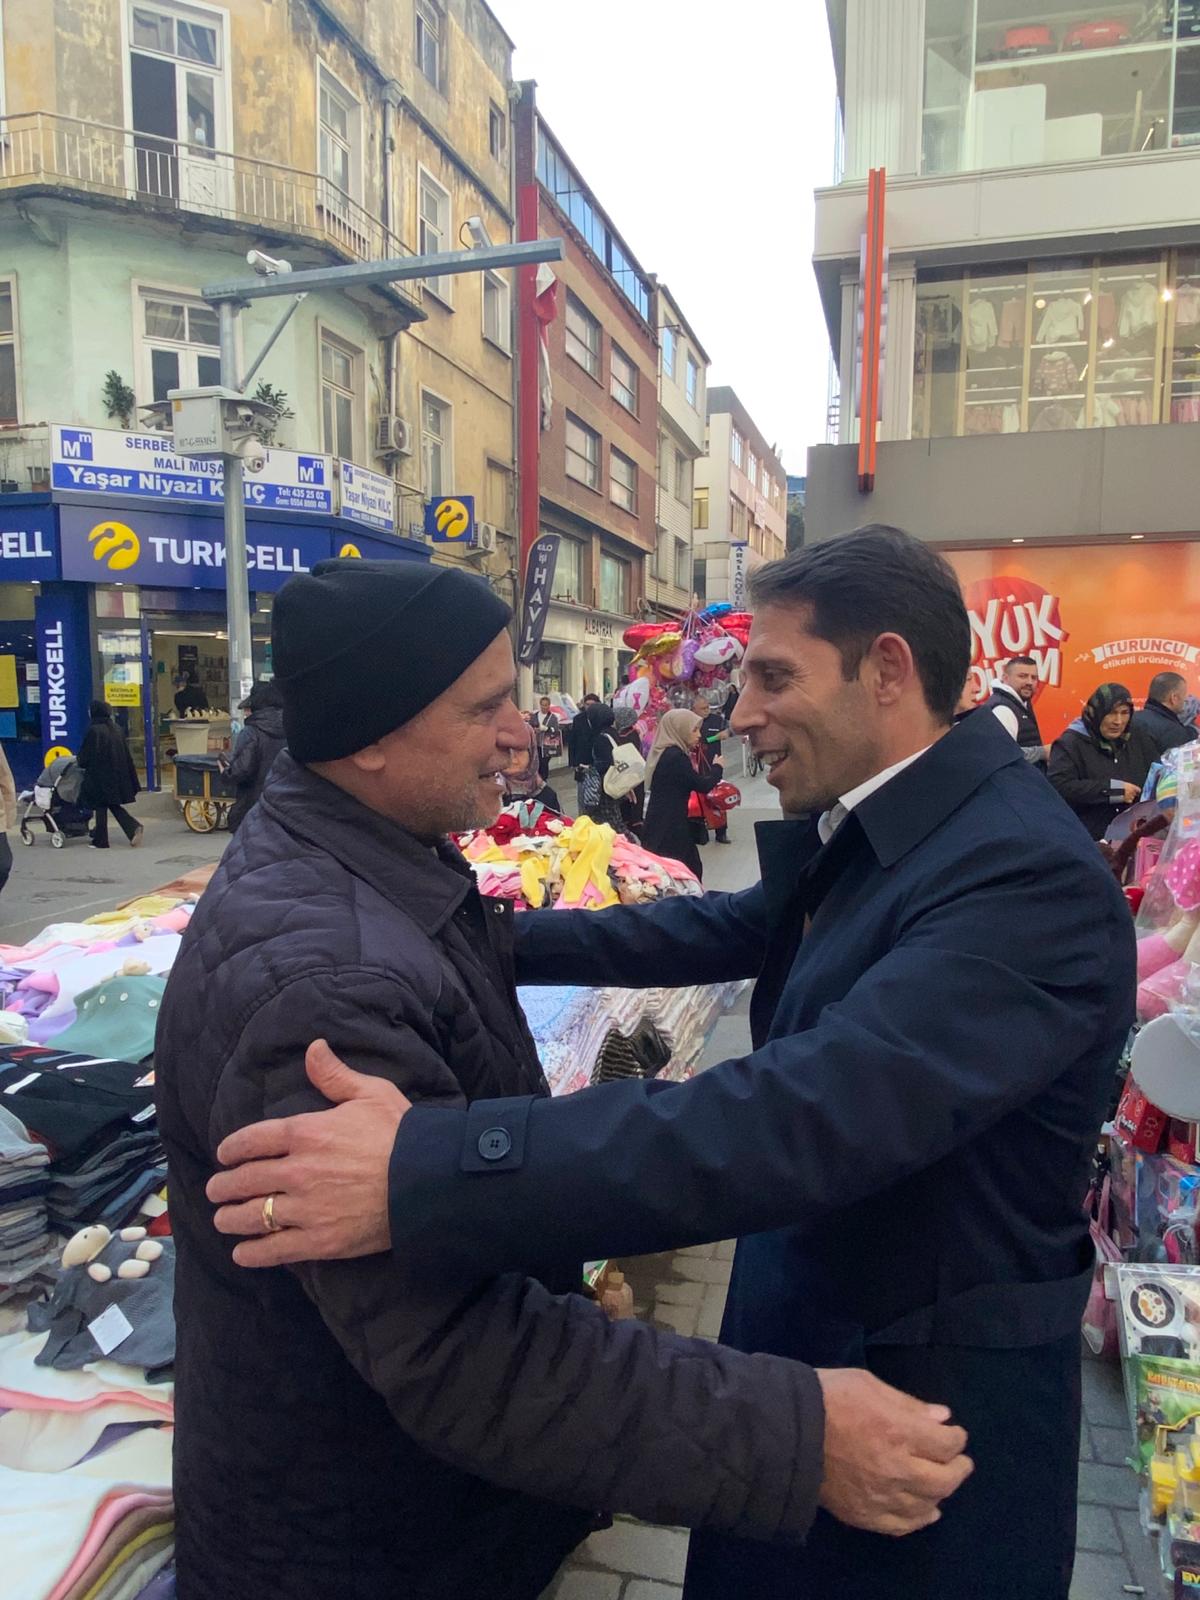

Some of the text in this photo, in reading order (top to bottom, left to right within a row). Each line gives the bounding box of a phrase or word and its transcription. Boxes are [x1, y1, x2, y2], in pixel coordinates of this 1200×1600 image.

[125, 437, 175, 453] SERBES
[154, 456, 185, 471] MALİ
[68, 466, 266, 504] Yaşar Niyazi KIÇ
[0, 532, 52, 558] ELL
[520, 567, 547, 658] HAVLU
[967, 594, 1065, 659] YÜK
[1109, 639, 1185, 655] TURUNCU
[1102, 656, 1136, 670] etiketli
[45, 620, 68, 741] TURKCELL
